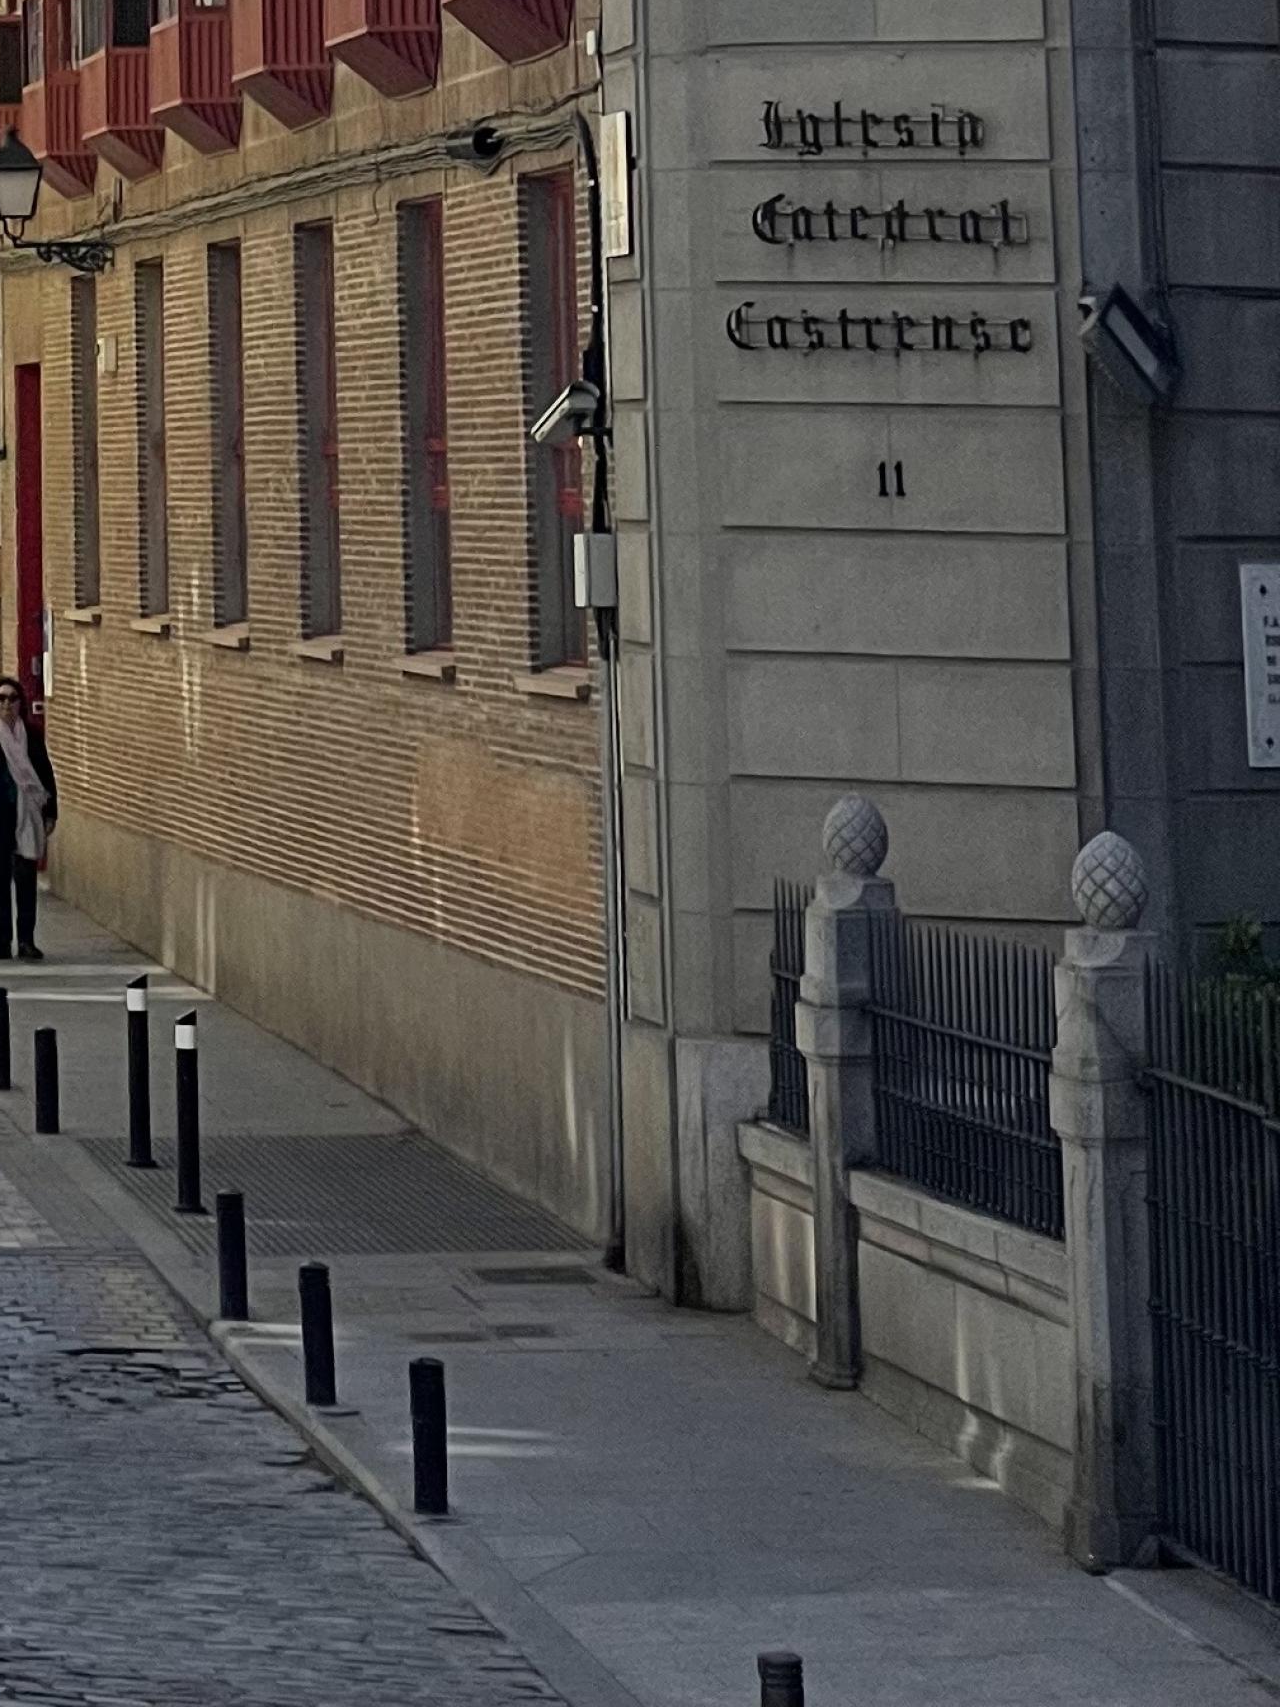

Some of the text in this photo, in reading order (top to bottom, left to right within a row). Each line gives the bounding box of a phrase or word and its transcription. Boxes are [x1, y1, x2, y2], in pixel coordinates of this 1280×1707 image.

[752, 194, 1013, 245] Catedral
[726, 302, 1033, 355] Castrense
[877, 460, 906, 498] 11
